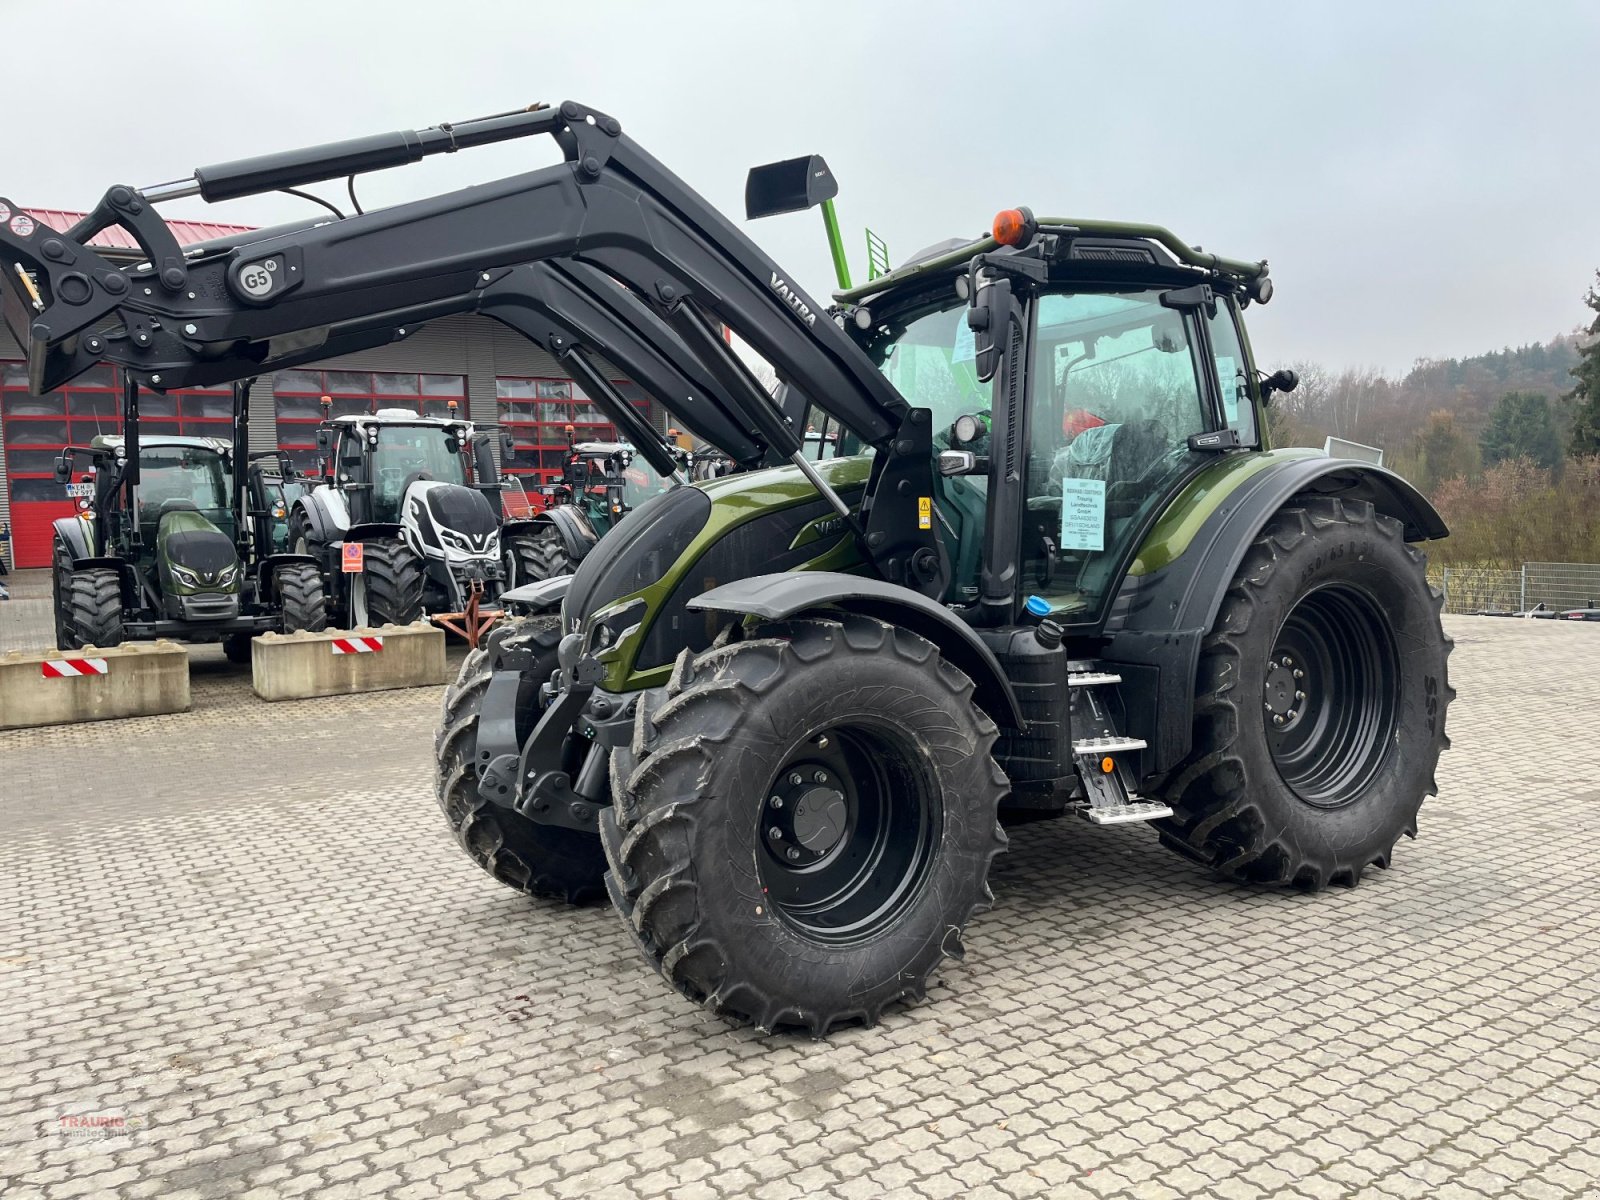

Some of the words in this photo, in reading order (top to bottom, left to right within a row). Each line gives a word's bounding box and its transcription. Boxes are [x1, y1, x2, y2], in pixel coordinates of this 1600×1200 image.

[266, 262, 275, 270] M
[244, 271, 268, 289] G5
[770, 271, 816, 328] VALTRA
